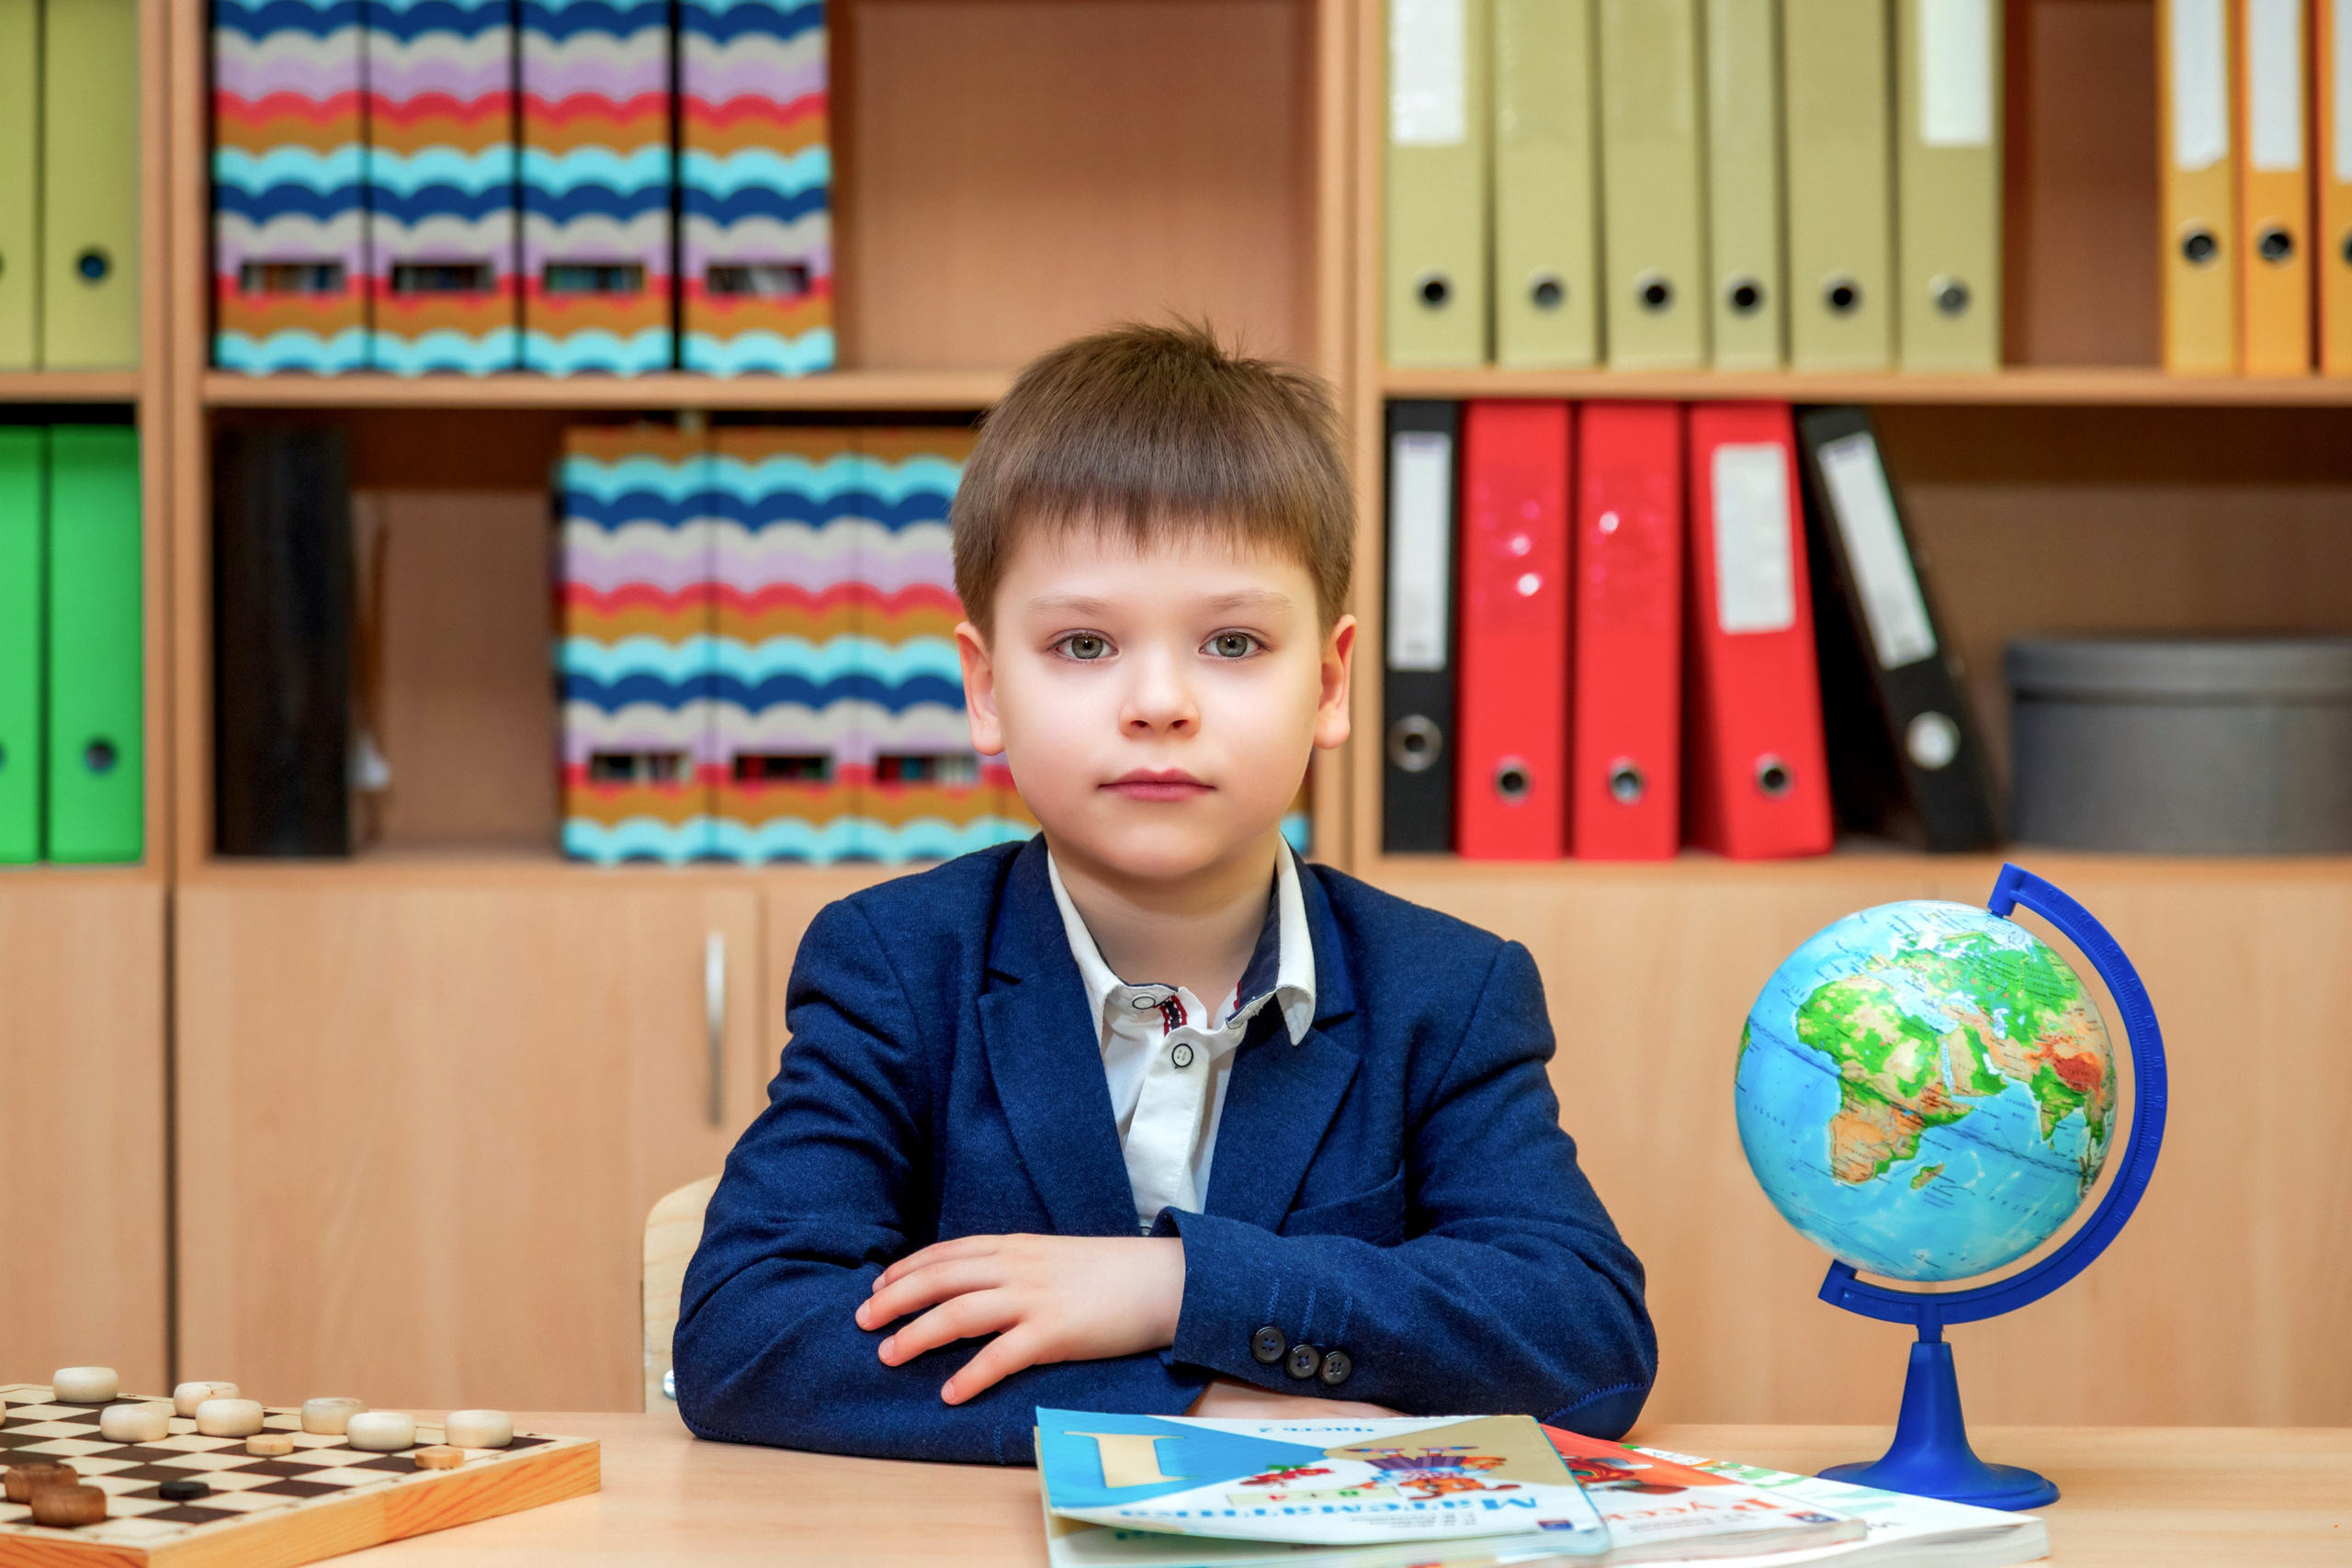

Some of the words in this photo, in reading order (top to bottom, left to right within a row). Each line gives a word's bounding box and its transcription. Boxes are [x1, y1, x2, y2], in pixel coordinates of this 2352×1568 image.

[2106, 942, 2120, 957] 60
[2129, 977, 2141, 992] 50
[2154, 1095, 2165, 1110] 20
[2149, 1135, 2159, 1148] 10
[1063, 1431, 1200, 1488] 1
[1120, 1496, 1538, 1518] Математика
